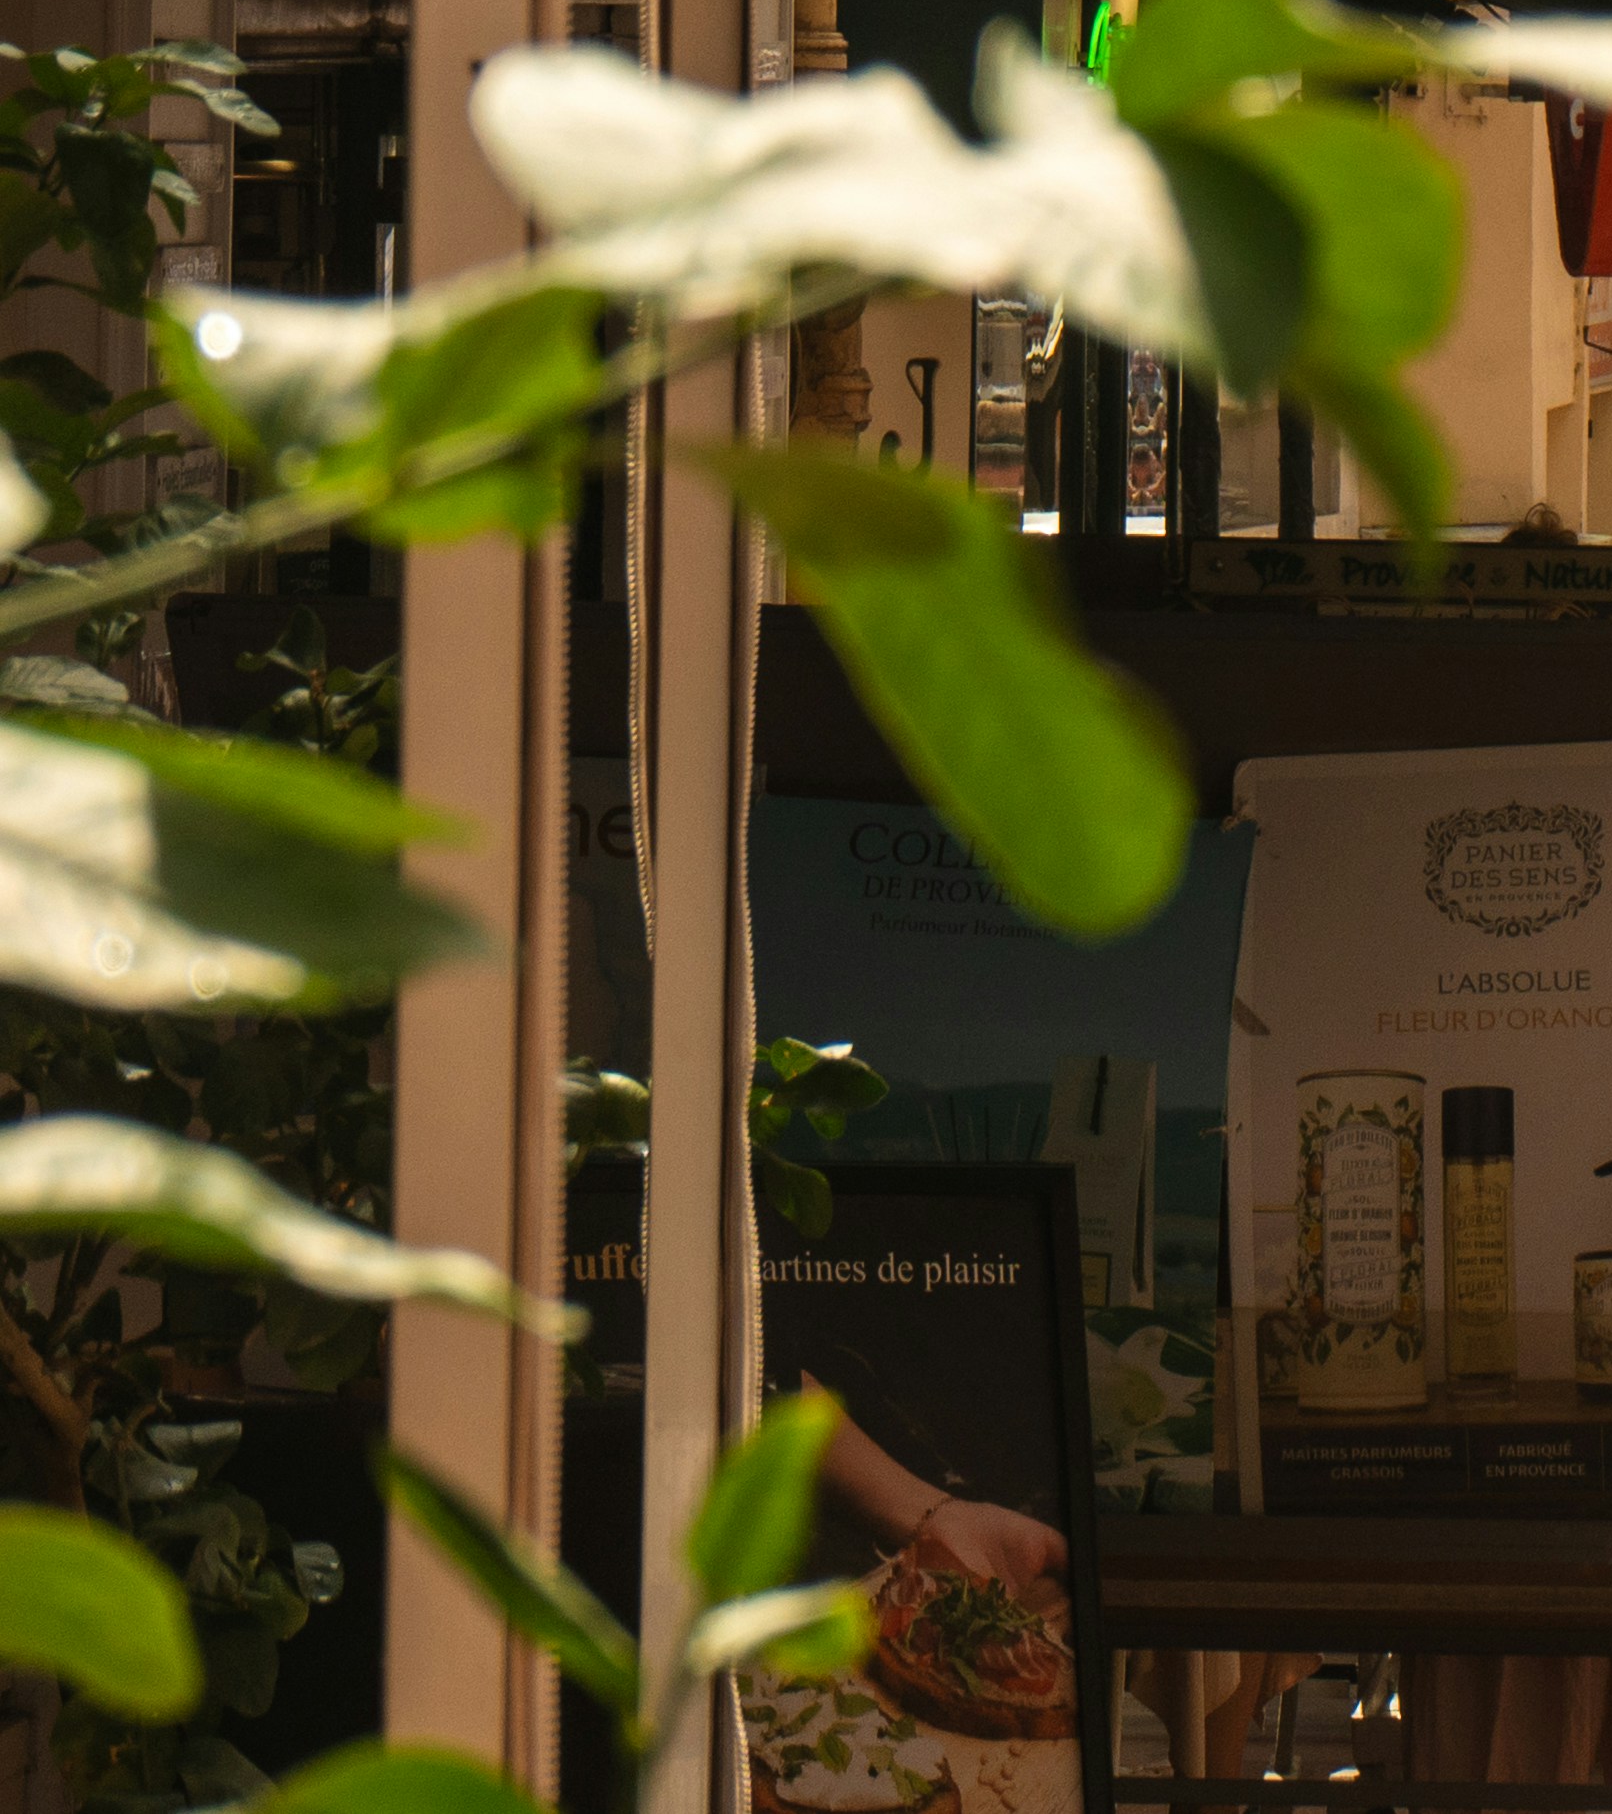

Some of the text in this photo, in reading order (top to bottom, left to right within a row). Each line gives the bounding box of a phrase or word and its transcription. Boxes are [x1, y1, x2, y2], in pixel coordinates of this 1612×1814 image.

[1465, 842, 1564, 866] PANIER
[863, 874, 902, 900] DE
[1449, 865, 1578, 891] DES SENS
[1465, 890, 1562, 904] EN PROVENCE
[870, 911, 969, 937] Parfumeur
[1437, 968, 1591, 996] L'ABSOLUE
[1376, 1008, 1470, 1034] FLEUR
[759, 1250, 867, 1286] artines
[876, 1250, 915, 1285] de
[924, 1252, 1021, 1293] plaisir
[1280, 1443, 1453, 1463] MAÎTRES PARFUMEURS
[1498, 1438, 1572, 1460] FABRIQUÉ
[1330, 1464, 1405, 1482] GRASSOIS
[1484, 1462, 1587, 1478] EN PROVENCE
